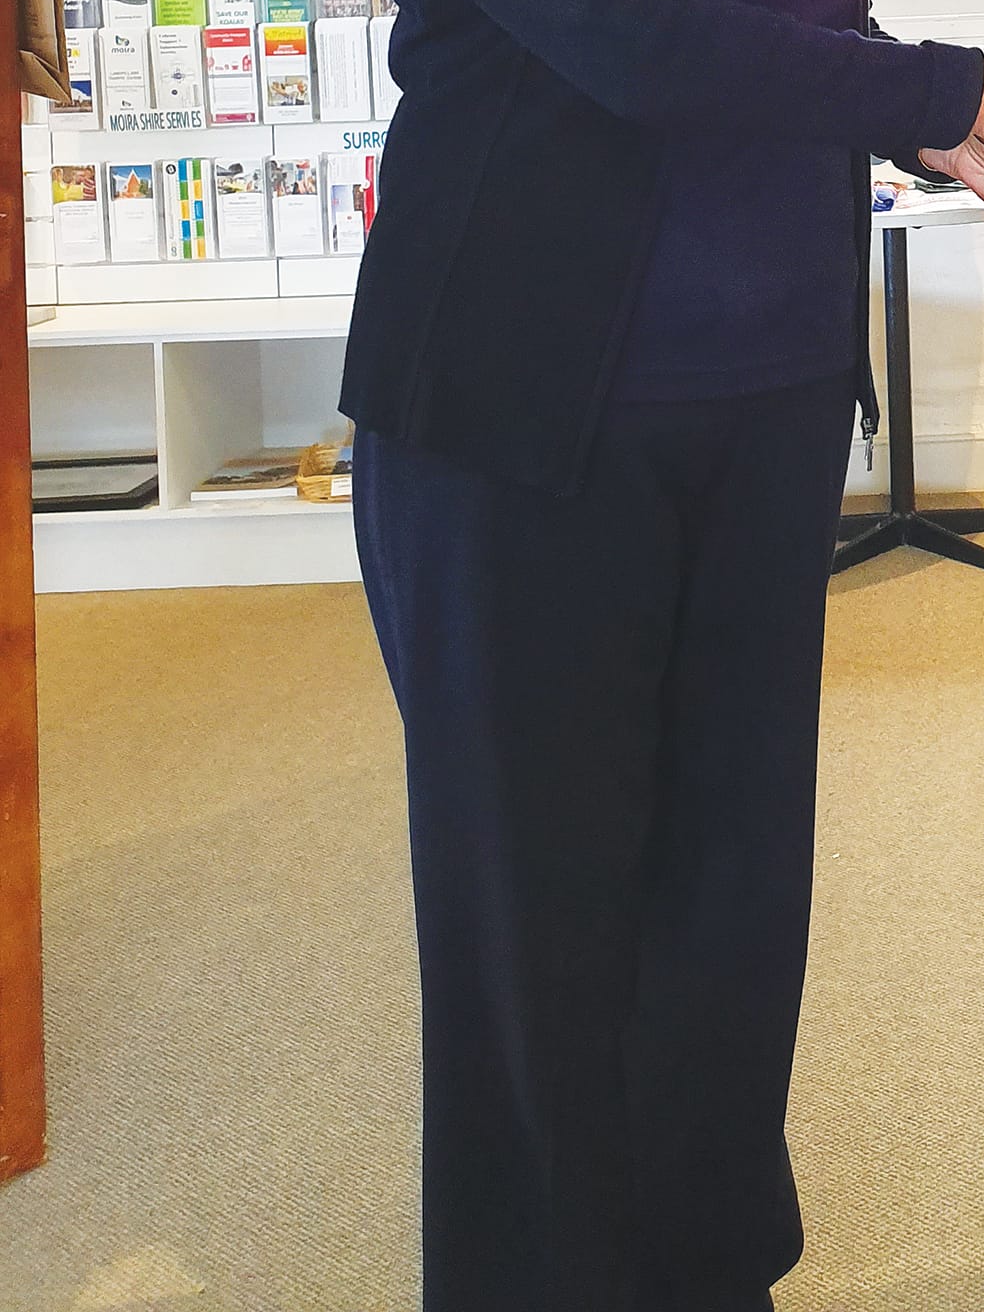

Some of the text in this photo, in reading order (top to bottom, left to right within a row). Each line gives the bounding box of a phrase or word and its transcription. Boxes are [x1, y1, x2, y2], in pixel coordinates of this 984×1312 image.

[110, 110, 202, 132] MOIRA SHIRE SERVIES
